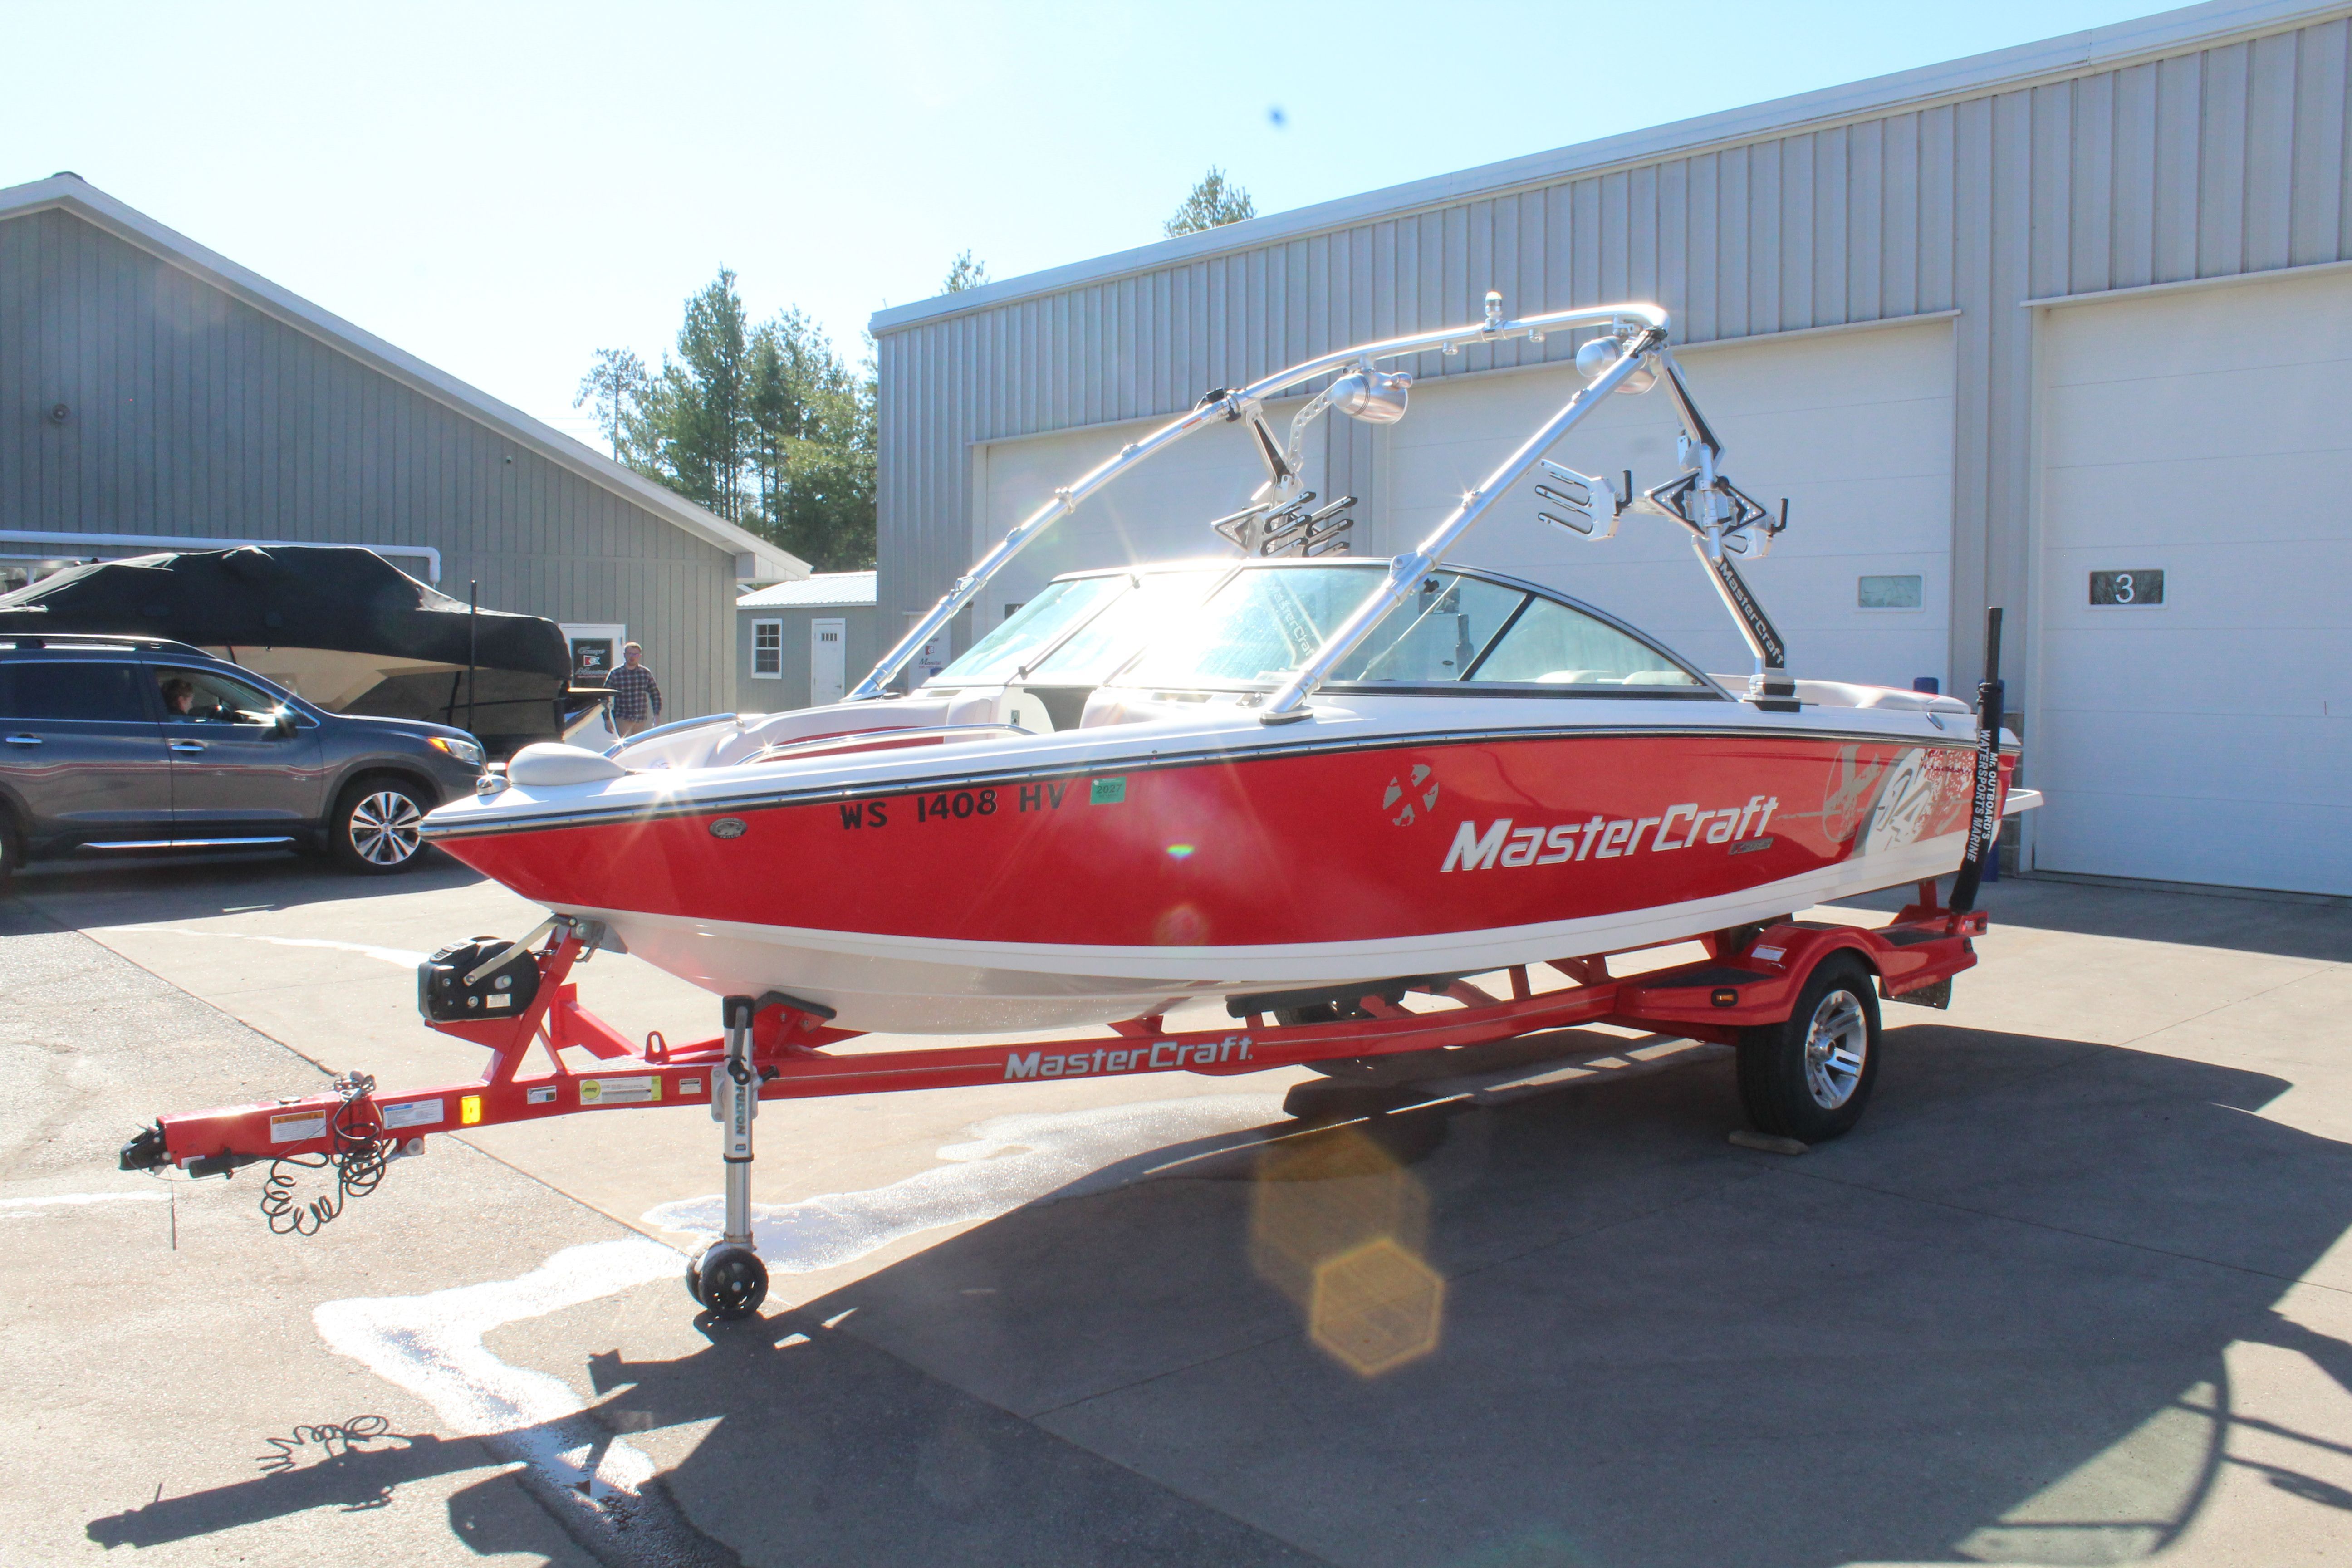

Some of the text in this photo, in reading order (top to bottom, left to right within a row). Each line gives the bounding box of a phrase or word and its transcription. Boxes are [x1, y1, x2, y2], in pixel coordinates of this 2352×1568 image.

[1433, 593, 1445, 613] 2
[2115, 573, 2135, 603] 3
[1719, 562, 1784, 664] MasterCraft
[840, 782, 1067, 830] WS 1408 HV
[1096, 784, 1122, 794] 2027
[1967, 729, 1991, 862] WATERSPORTS MARINE
[1982, 752, 1998, 840] Mr. OUTBOARD'S
[1440, 795, 1779, 872] MasterCraft
[735, 1086, 746, 1134] FULTON
